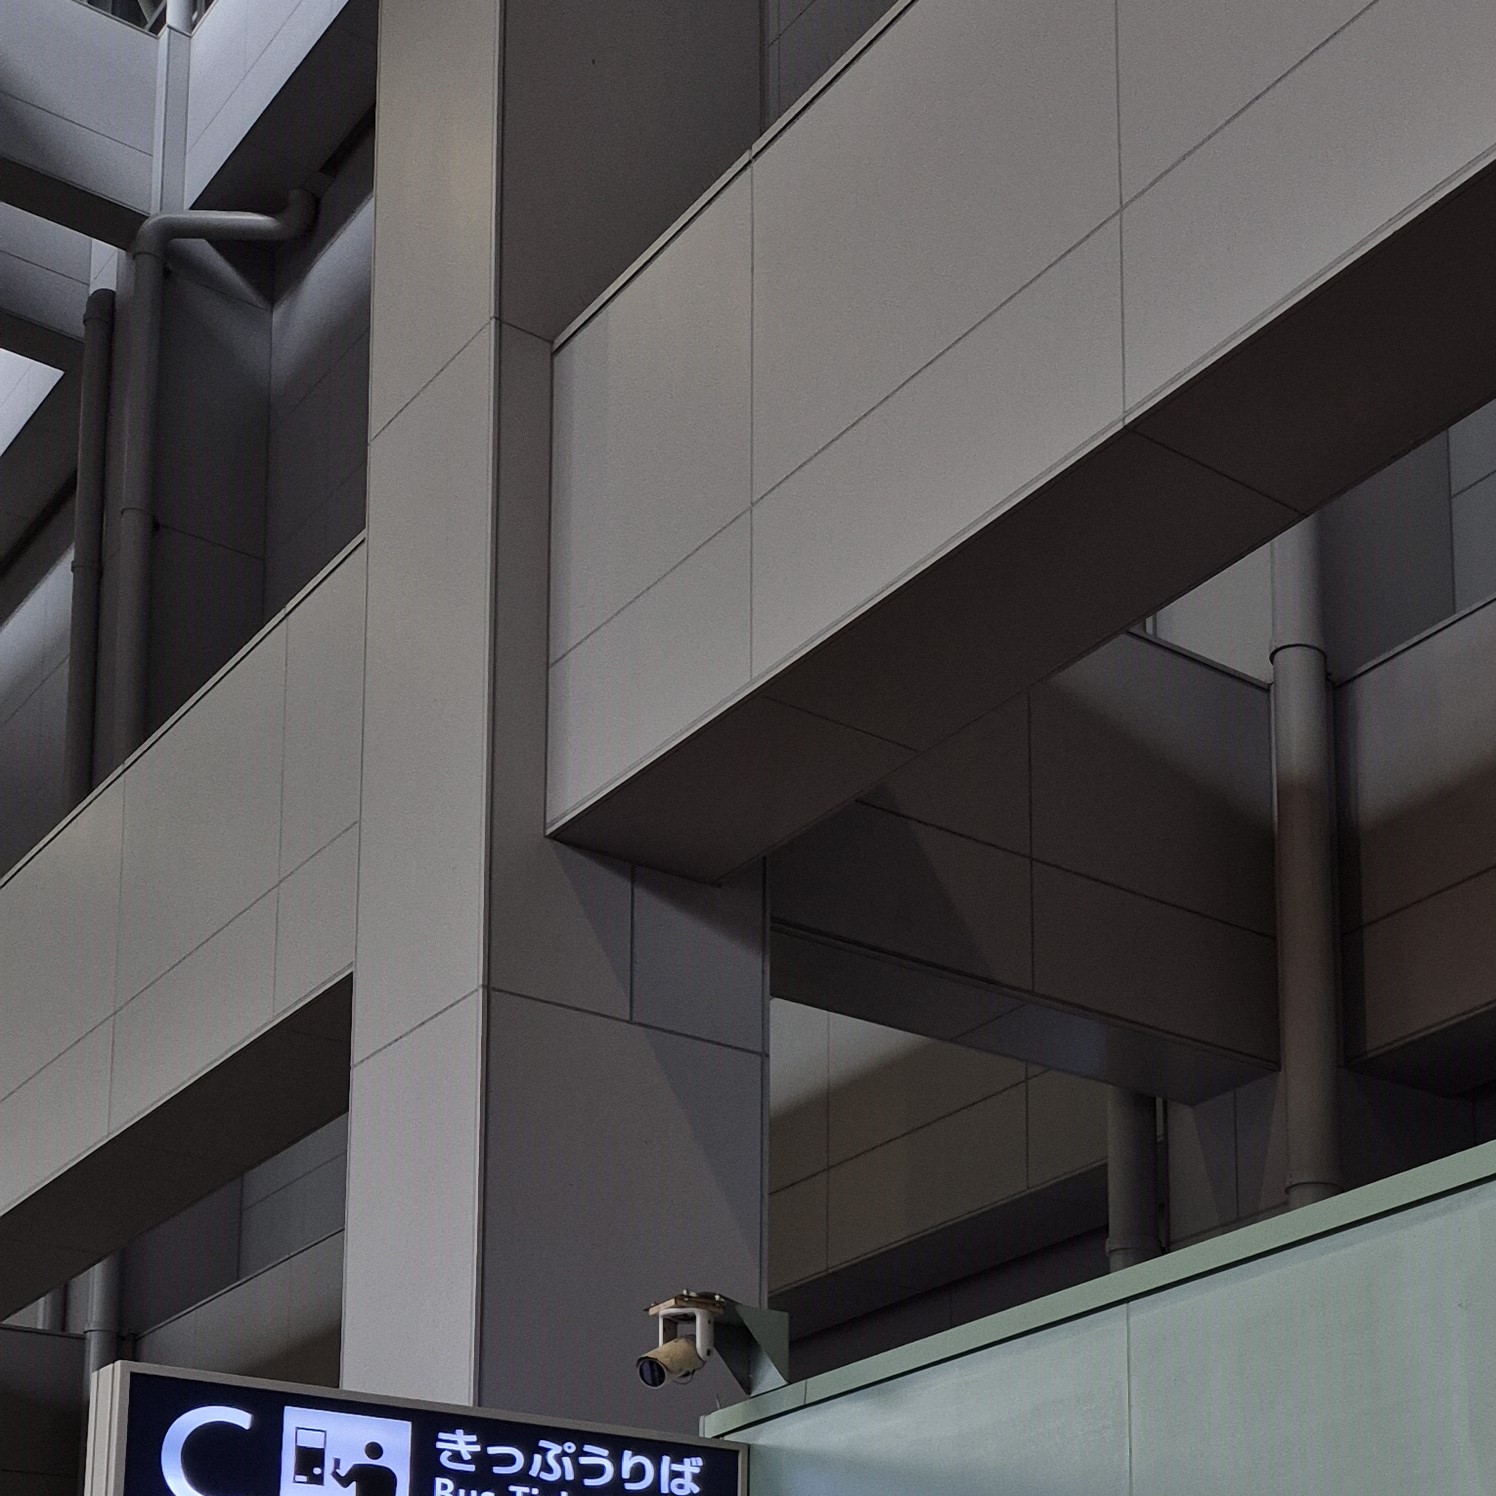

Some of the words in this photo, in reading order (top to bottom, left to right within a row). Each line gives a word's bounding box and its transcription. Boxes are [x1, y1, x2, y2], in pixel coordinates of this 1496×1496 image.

[435, 1428, 704, 1496] きっぷうりば
